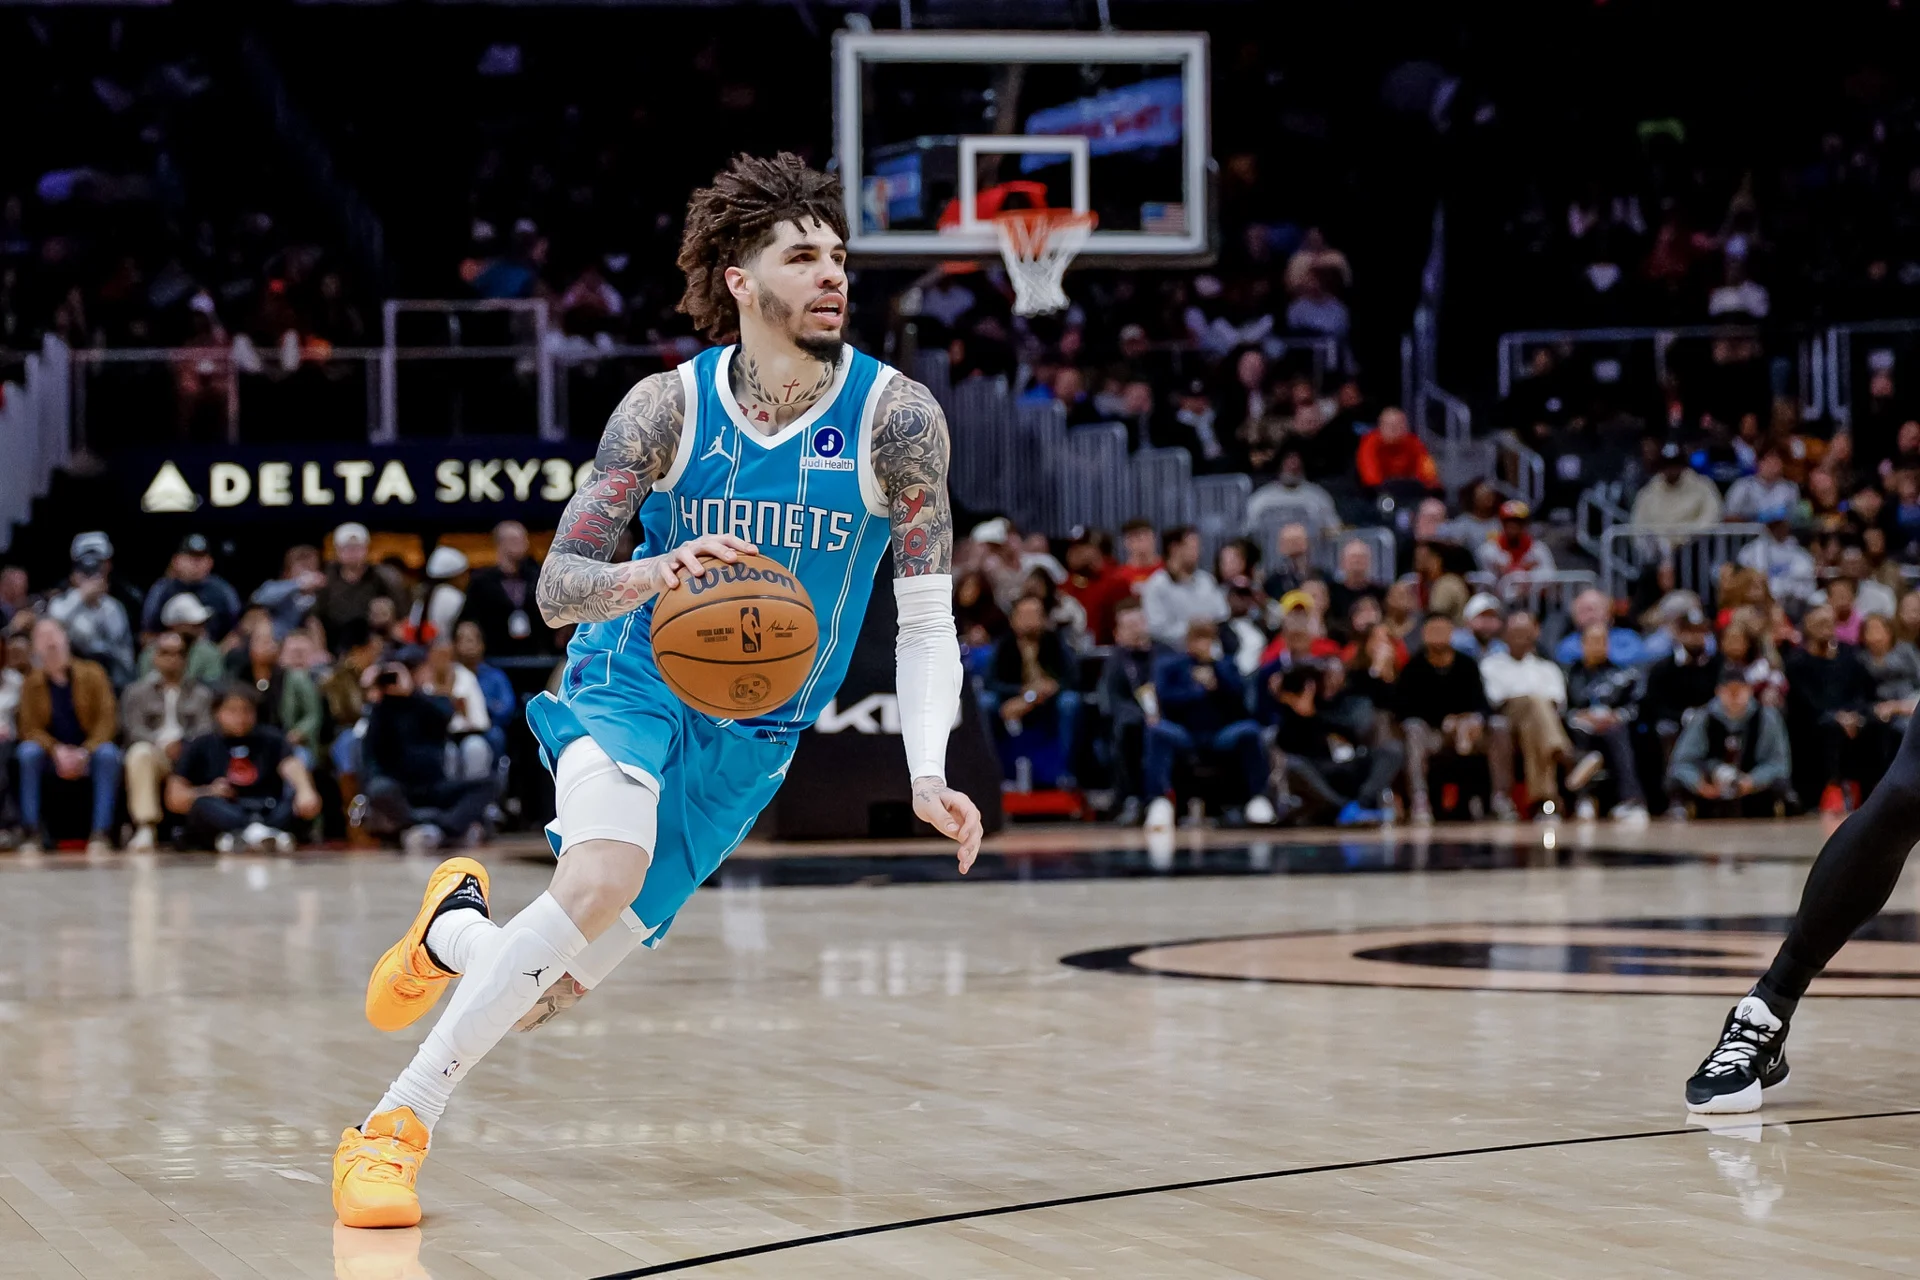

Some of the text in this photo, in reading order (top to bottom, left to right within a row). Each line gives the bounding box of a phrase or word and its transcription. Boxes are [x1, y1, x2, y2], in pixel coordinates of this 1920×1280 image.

[210, 460, 417, 507] DELTA
[802, 460, 853, 470] Judi Health
[680, 496, 853, 552] HORNETS
[685, 561, 797, 594] Wilson
